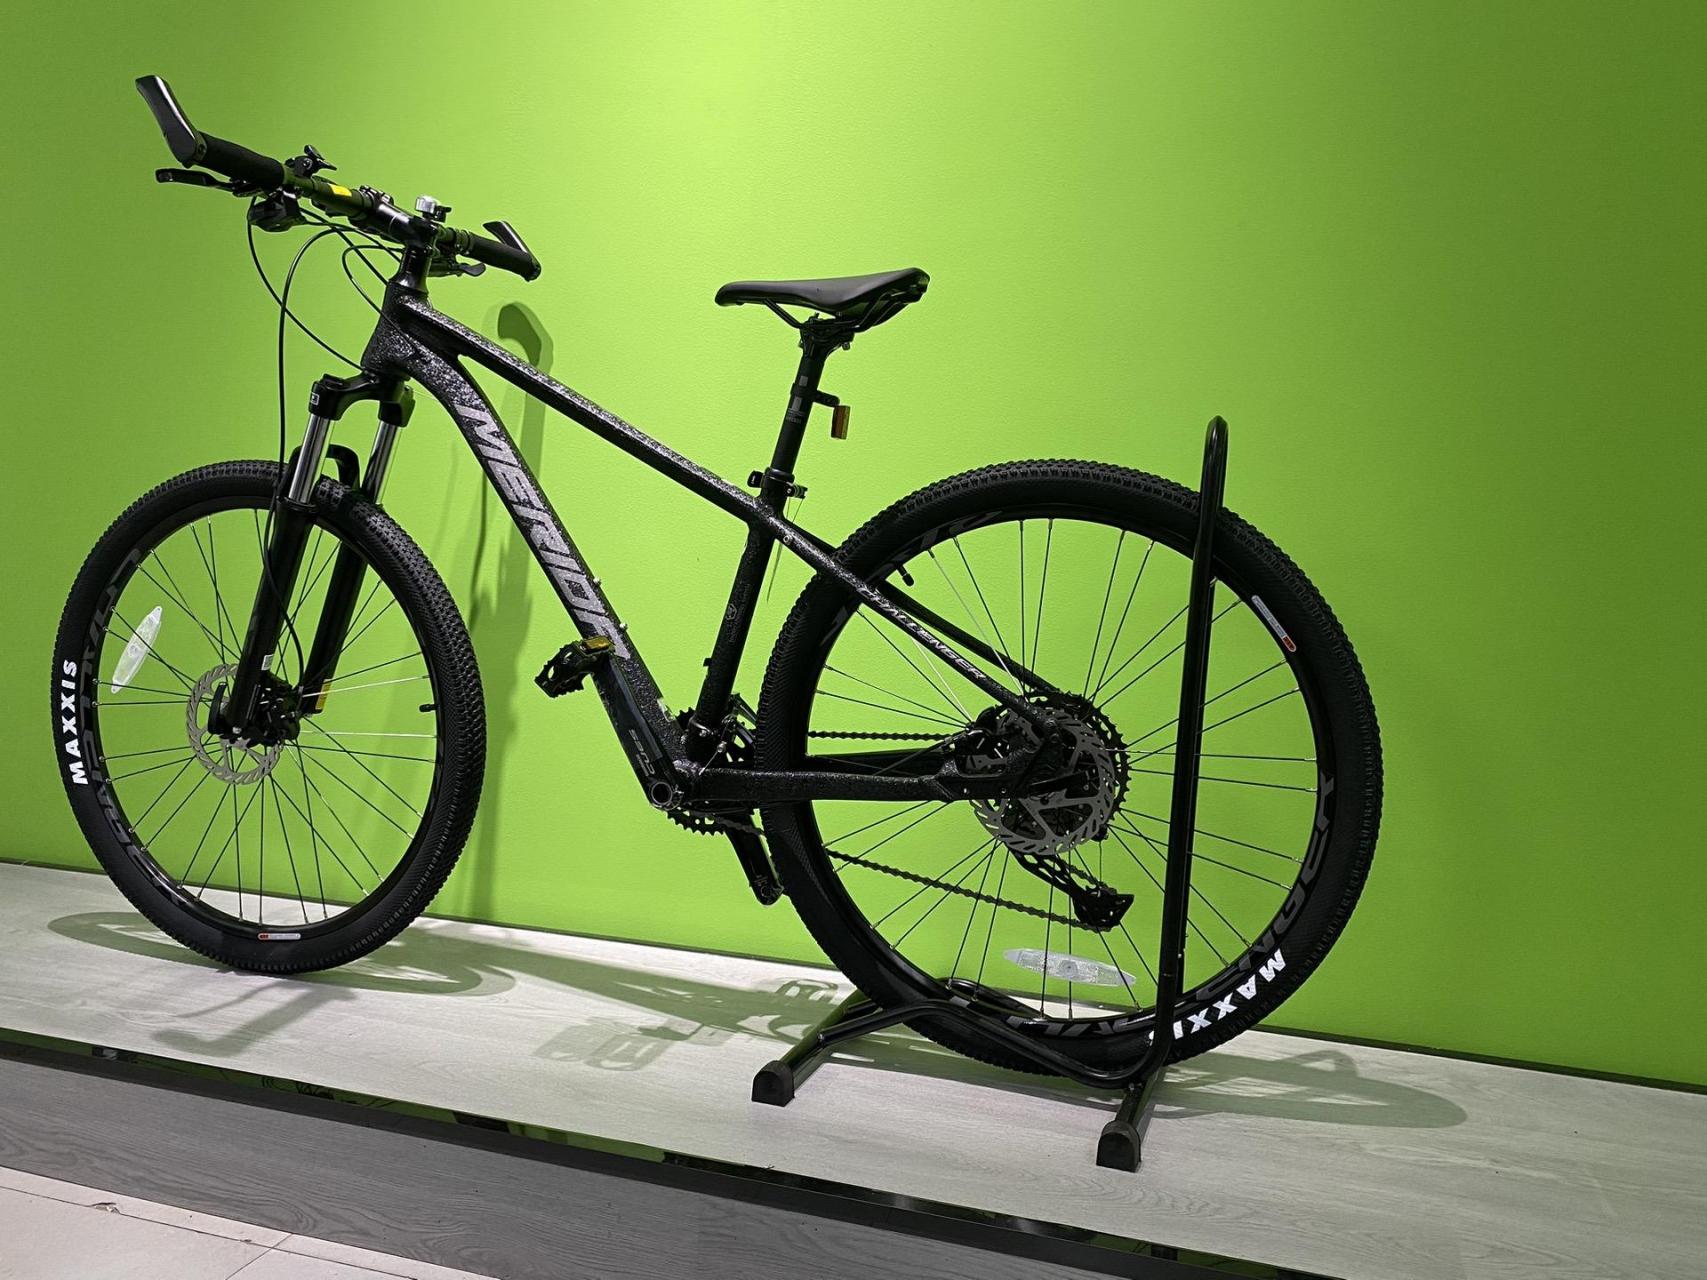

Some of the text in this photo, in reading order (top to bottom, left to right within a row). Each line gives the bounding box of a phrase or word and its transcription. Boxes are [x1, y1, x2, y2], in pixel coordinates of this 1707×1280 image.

[857, 586, 987, 679] CHALLENGER
[61, 659, 88, 785] MAXXIS
[1149, 949, 1286, 1046] MAXXI
